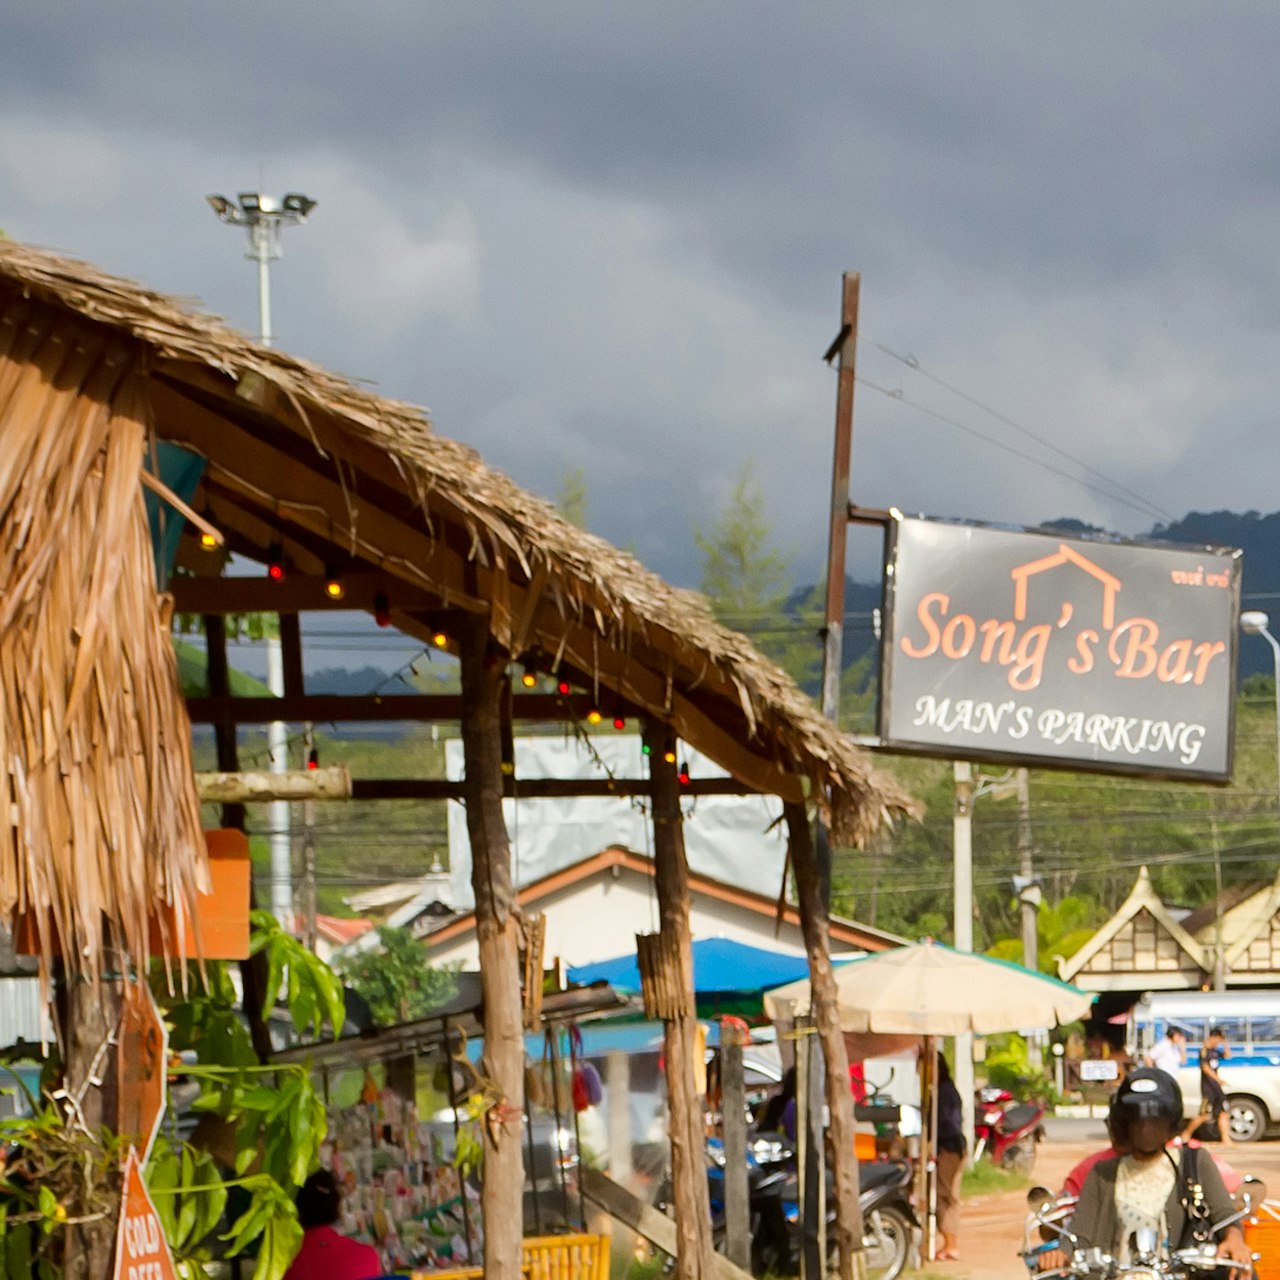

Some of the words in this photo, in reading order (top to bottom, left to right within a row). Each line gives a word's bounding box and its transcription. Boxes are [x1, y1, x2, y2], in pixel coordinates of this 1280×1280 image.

[900, 592, 1099, 691] Song's
[1108, 617, 1225, 685] Bar
[913, 695, 1033, 739] MAN'S
[1037, 709, 1206, 765] PARKING
[125, 1213, 159, 1259] COLD
